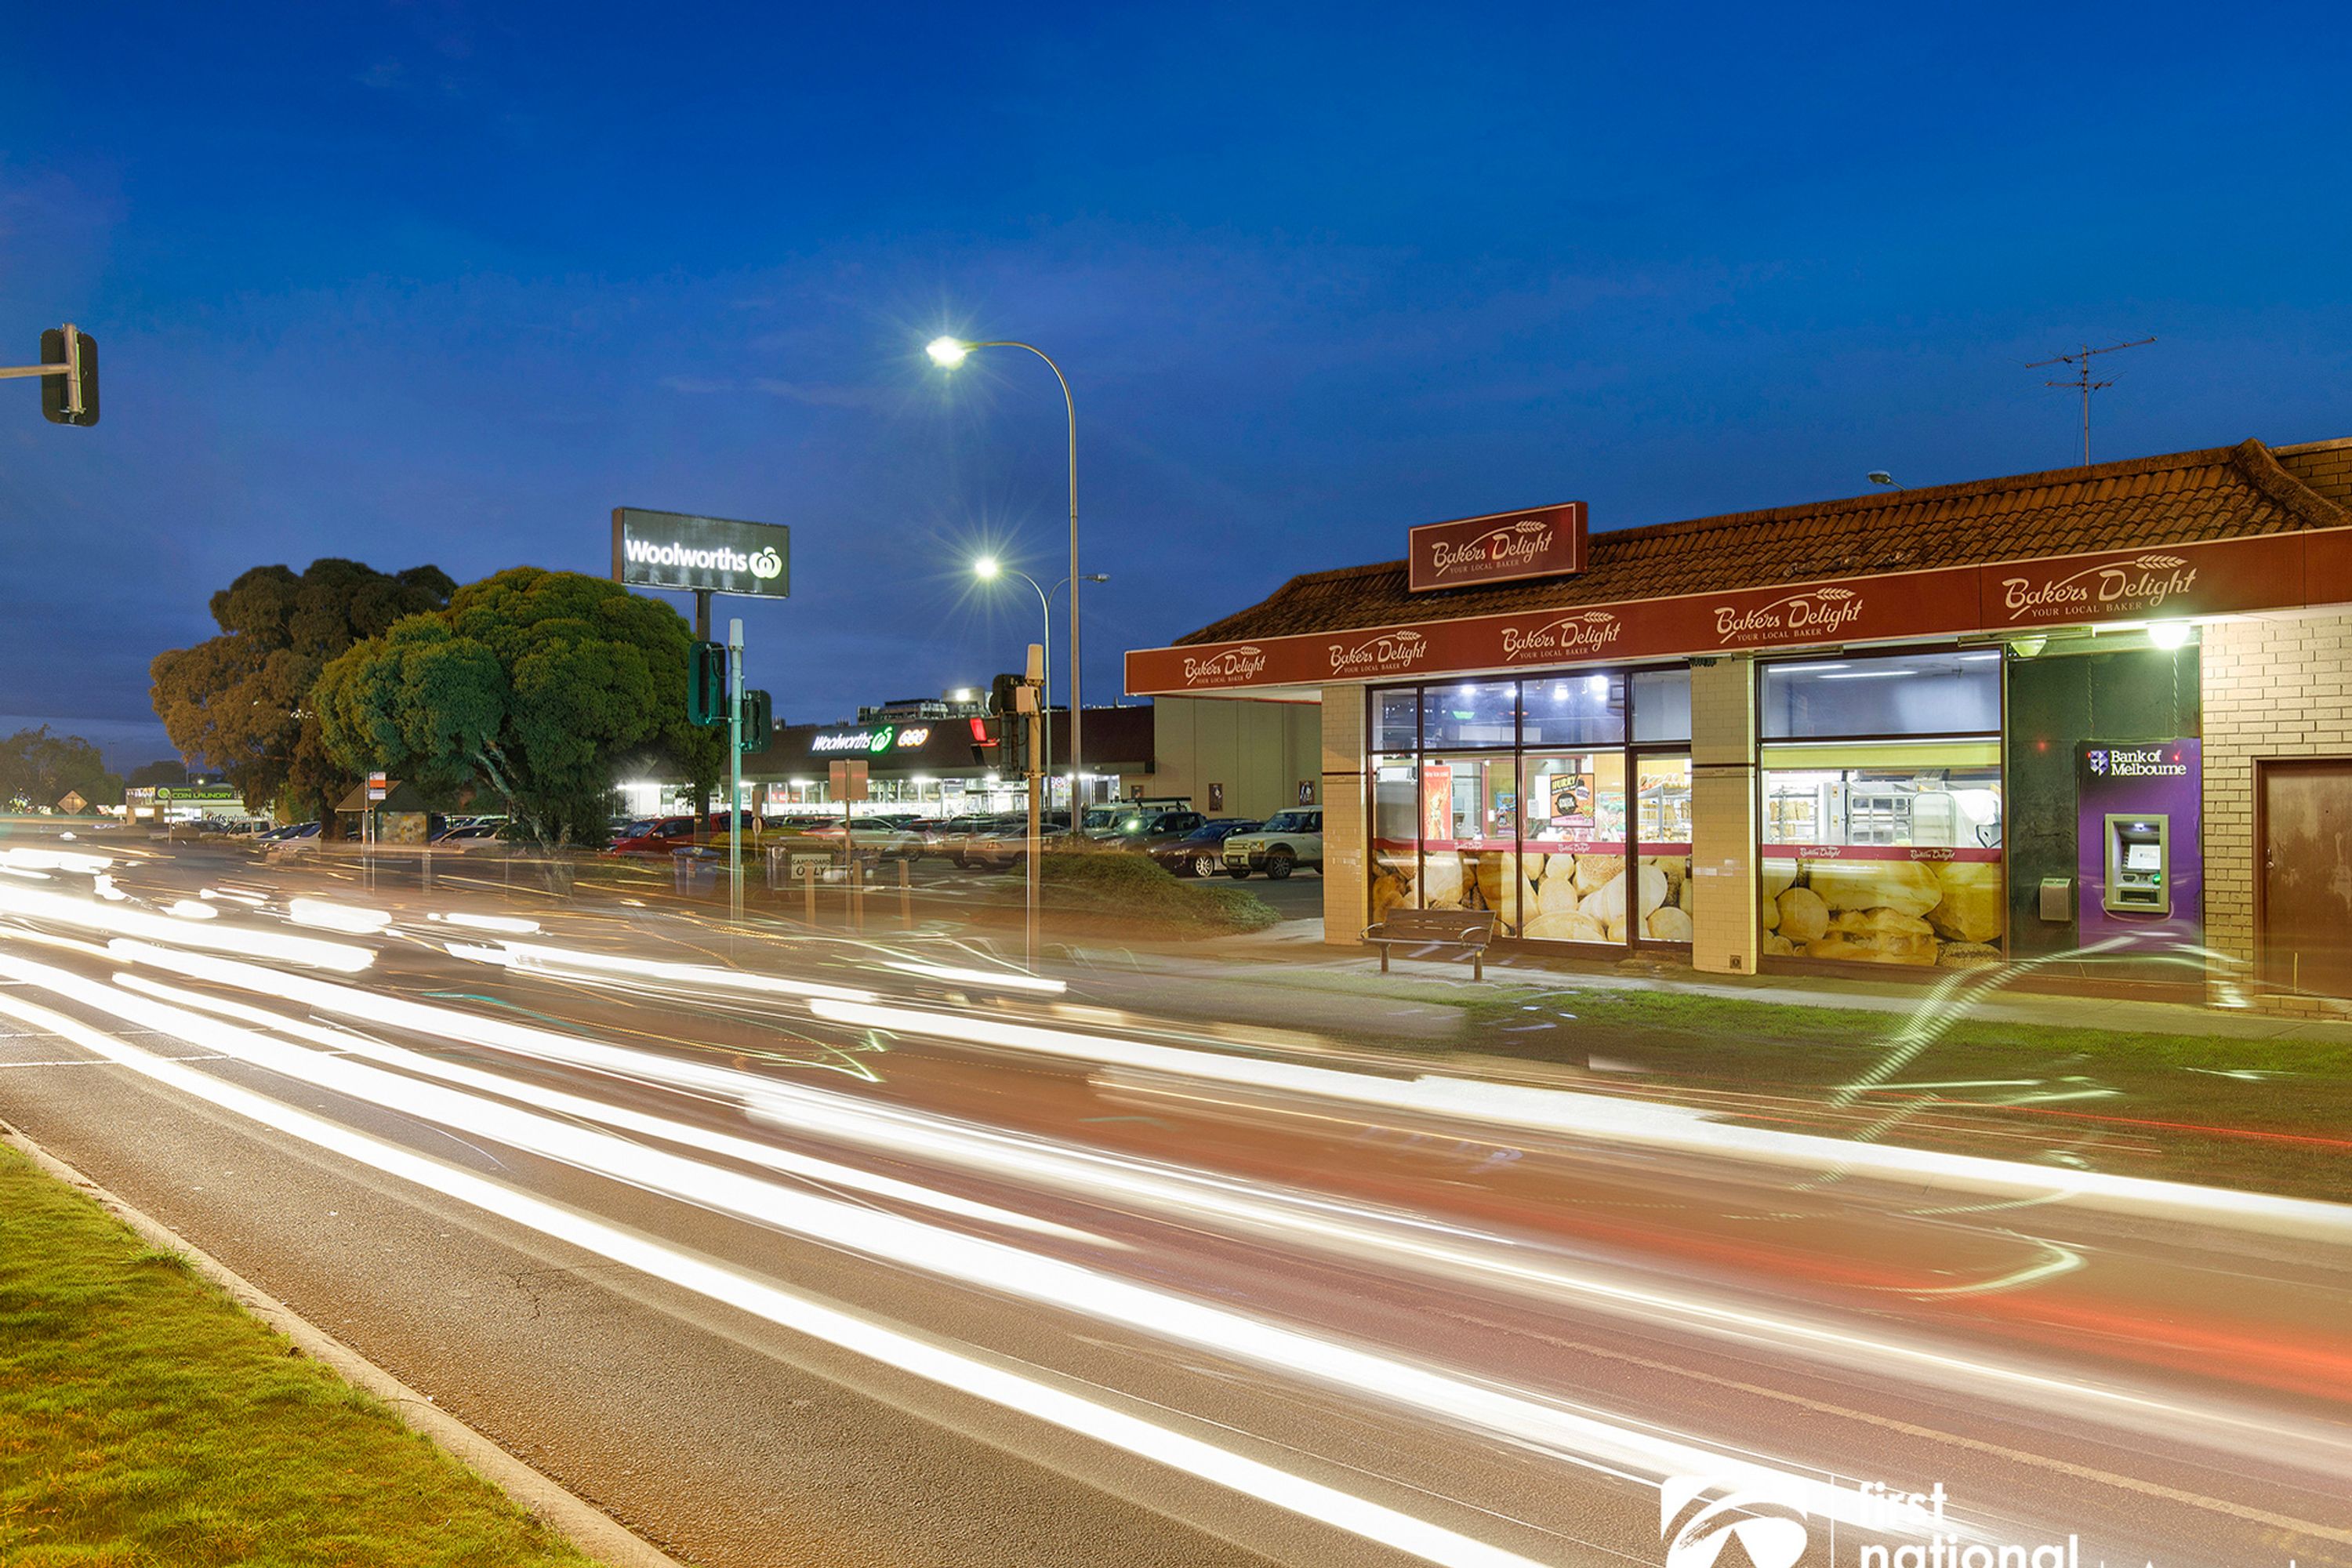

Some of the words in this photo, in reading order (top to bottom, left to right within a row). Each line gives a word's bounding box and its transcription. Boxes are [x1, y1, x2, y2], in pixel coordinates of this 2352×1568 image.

[626, 539, 748, 572] Woolworths
[1432, 542, 1486, 569] Bakers
[1492, 531, 1553, 564] Delight
[1450, 566, 1468, 575] YOUR
[1471, 564, 1492, 572] LOCAL
[1496, 559, 1519, 568] BAKER
[2002, 578, 2089, 610] Bakers
[2098, 568, 2198, 607] Delight
[1714, 607, 1780, 635] Bakers
[1788, 599, 1864, 633] Delight
[2031, 608, 2060, 618] YOUR
[2065, 605, 2100, 615] LOCAL
[2107, 602, 2143, 612] BAKER
[1501, 628, 1555, 653] Bakers
[1561, 622, 1621, 652] Delight
[1737, 633, 1759, 642] YOUR
[1794, 628, 1822, 637] BAKER
[1328, 645, 1374, 667] Bakers
[1377, 640, 1427, 667] Delight
[1184, 658, 1221, 679] Bakers
[1225, 654, 1266, 680] Delight
[812, 732, 873, 751] Woolworths
[2111, 750, 2147, 763] Bank
[2147, 749, 2162, 763] of
[2111, 763, 2187, 776] Melbourne
[796, 866, 826, 877] OLY
